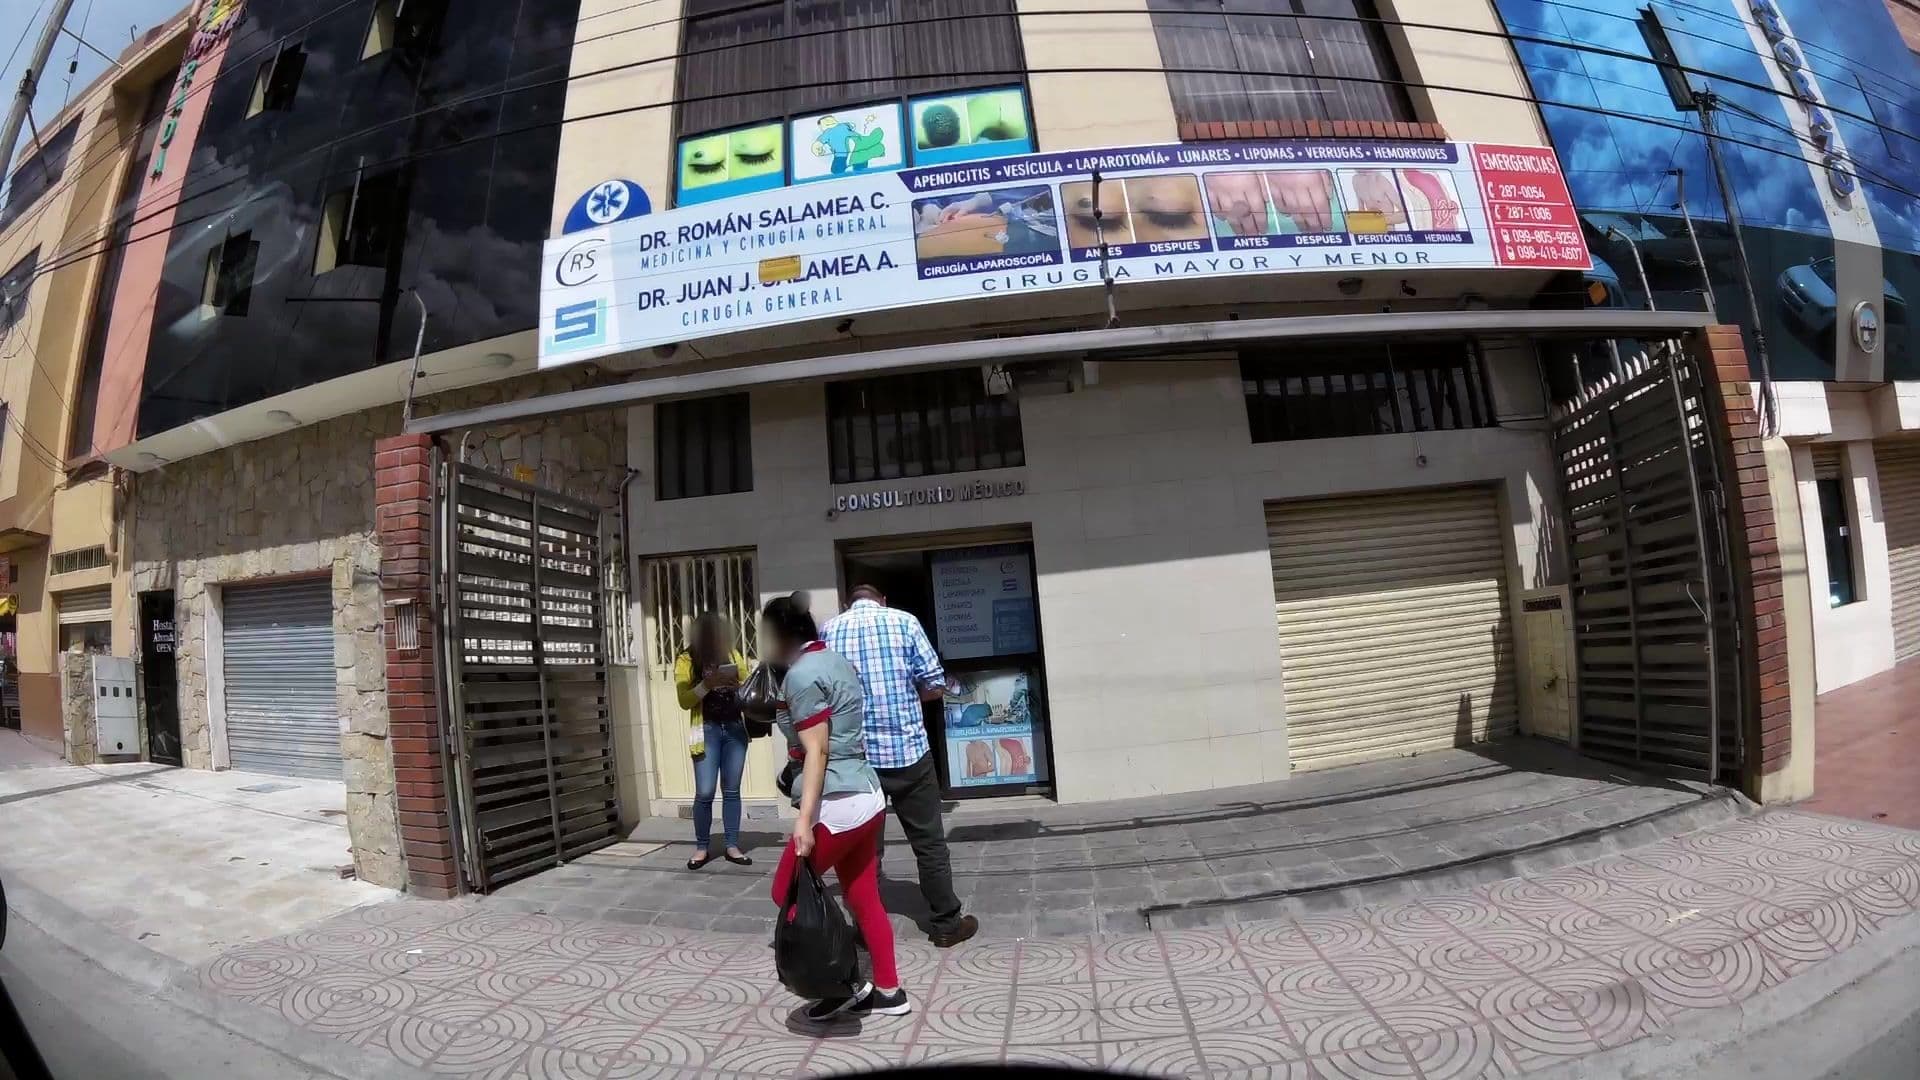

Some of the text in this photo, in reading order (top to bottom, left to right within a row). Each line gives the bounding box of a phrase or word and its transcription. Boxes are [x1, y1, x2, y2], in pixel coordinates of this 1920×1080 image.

[913, 146, 1449, 189] APENDICITIS VESÍCULA LAPAROTOMÍA LUNARES LIPOMAS VERRUGAS HEMORROIDES
[1479, 153, 1556, 174] EMERGENCIAS
[1499, 184, 1546, 200] 287-0054
[639, 191, 891, 253] DR. ROMÁN SALAMEA C.
[640, 215, 887, 270] MEDICINA Y CIRUGÍA GENERAL
[1150, 240, 1201, 253] DESPUES
[1233, 236, 1270, 248] ANTES
[1295, 234, 1343, 246] DESPUES
[1357, 233, 1414, 244] PERITONITIS
[1424, 232, 1463, 243] HERNIAS
[1085, 246, 1123, 259] ANES
[1155, 256, 1269, 275] MAYOR
[1289, 254, 1303, 266] Y
[1325, 250, 1431, 265] MENOR
[924, 252, 1054, 277] CIRUGÍA LAPAROSCOPÍA
[638, 250, 899, 311] DR. JUAN J. AMEA A.
[682, 285, 843, 327] CIRUGÍA GENERAL
[959, 480, 1026, 501] MÉDICO
